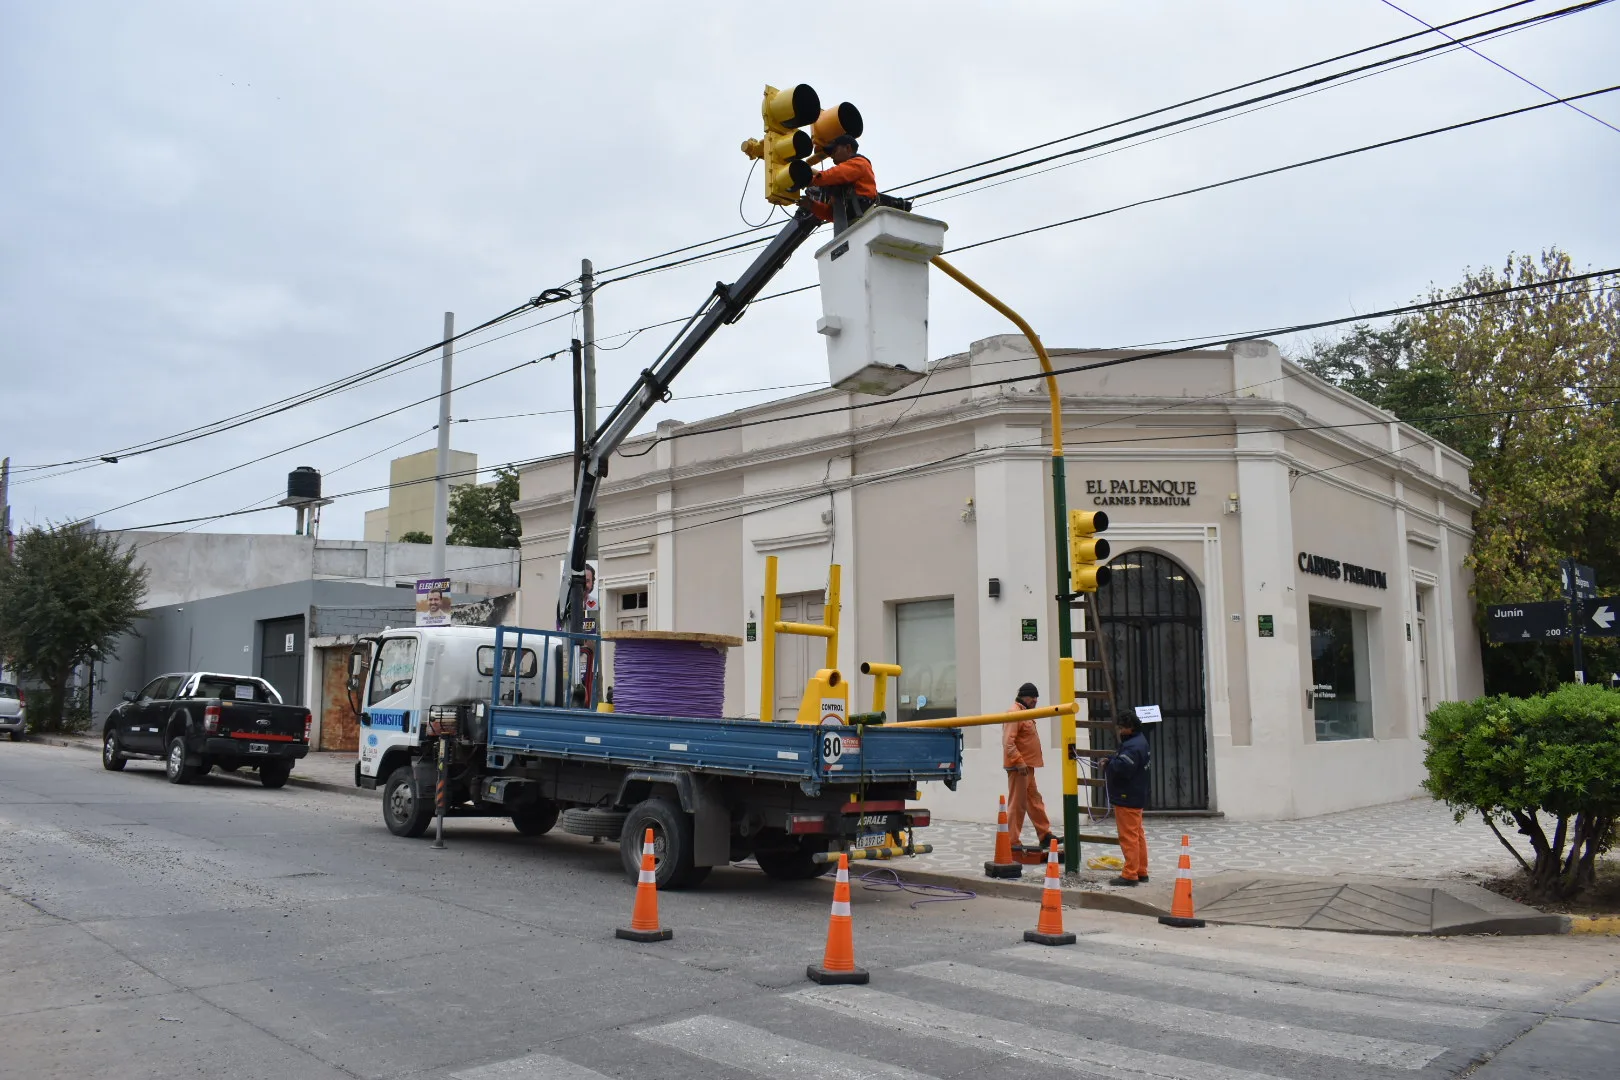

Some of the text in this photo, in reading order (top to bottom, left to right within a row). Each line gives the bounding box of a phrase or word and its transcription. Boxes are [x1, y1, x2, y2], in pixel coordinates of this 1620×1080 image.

[1086, 480, 1197, 496] EL PALENQUE
[1094, 497, 1191, 506] CARNES PREMIUM
[1298, 552, 1387, 590] CARNES PREMIUM
[1494, 608, 1524, 618] Junín
[1545, 628, 1561, 637] 200
[823, 737, 841, 757] 80
